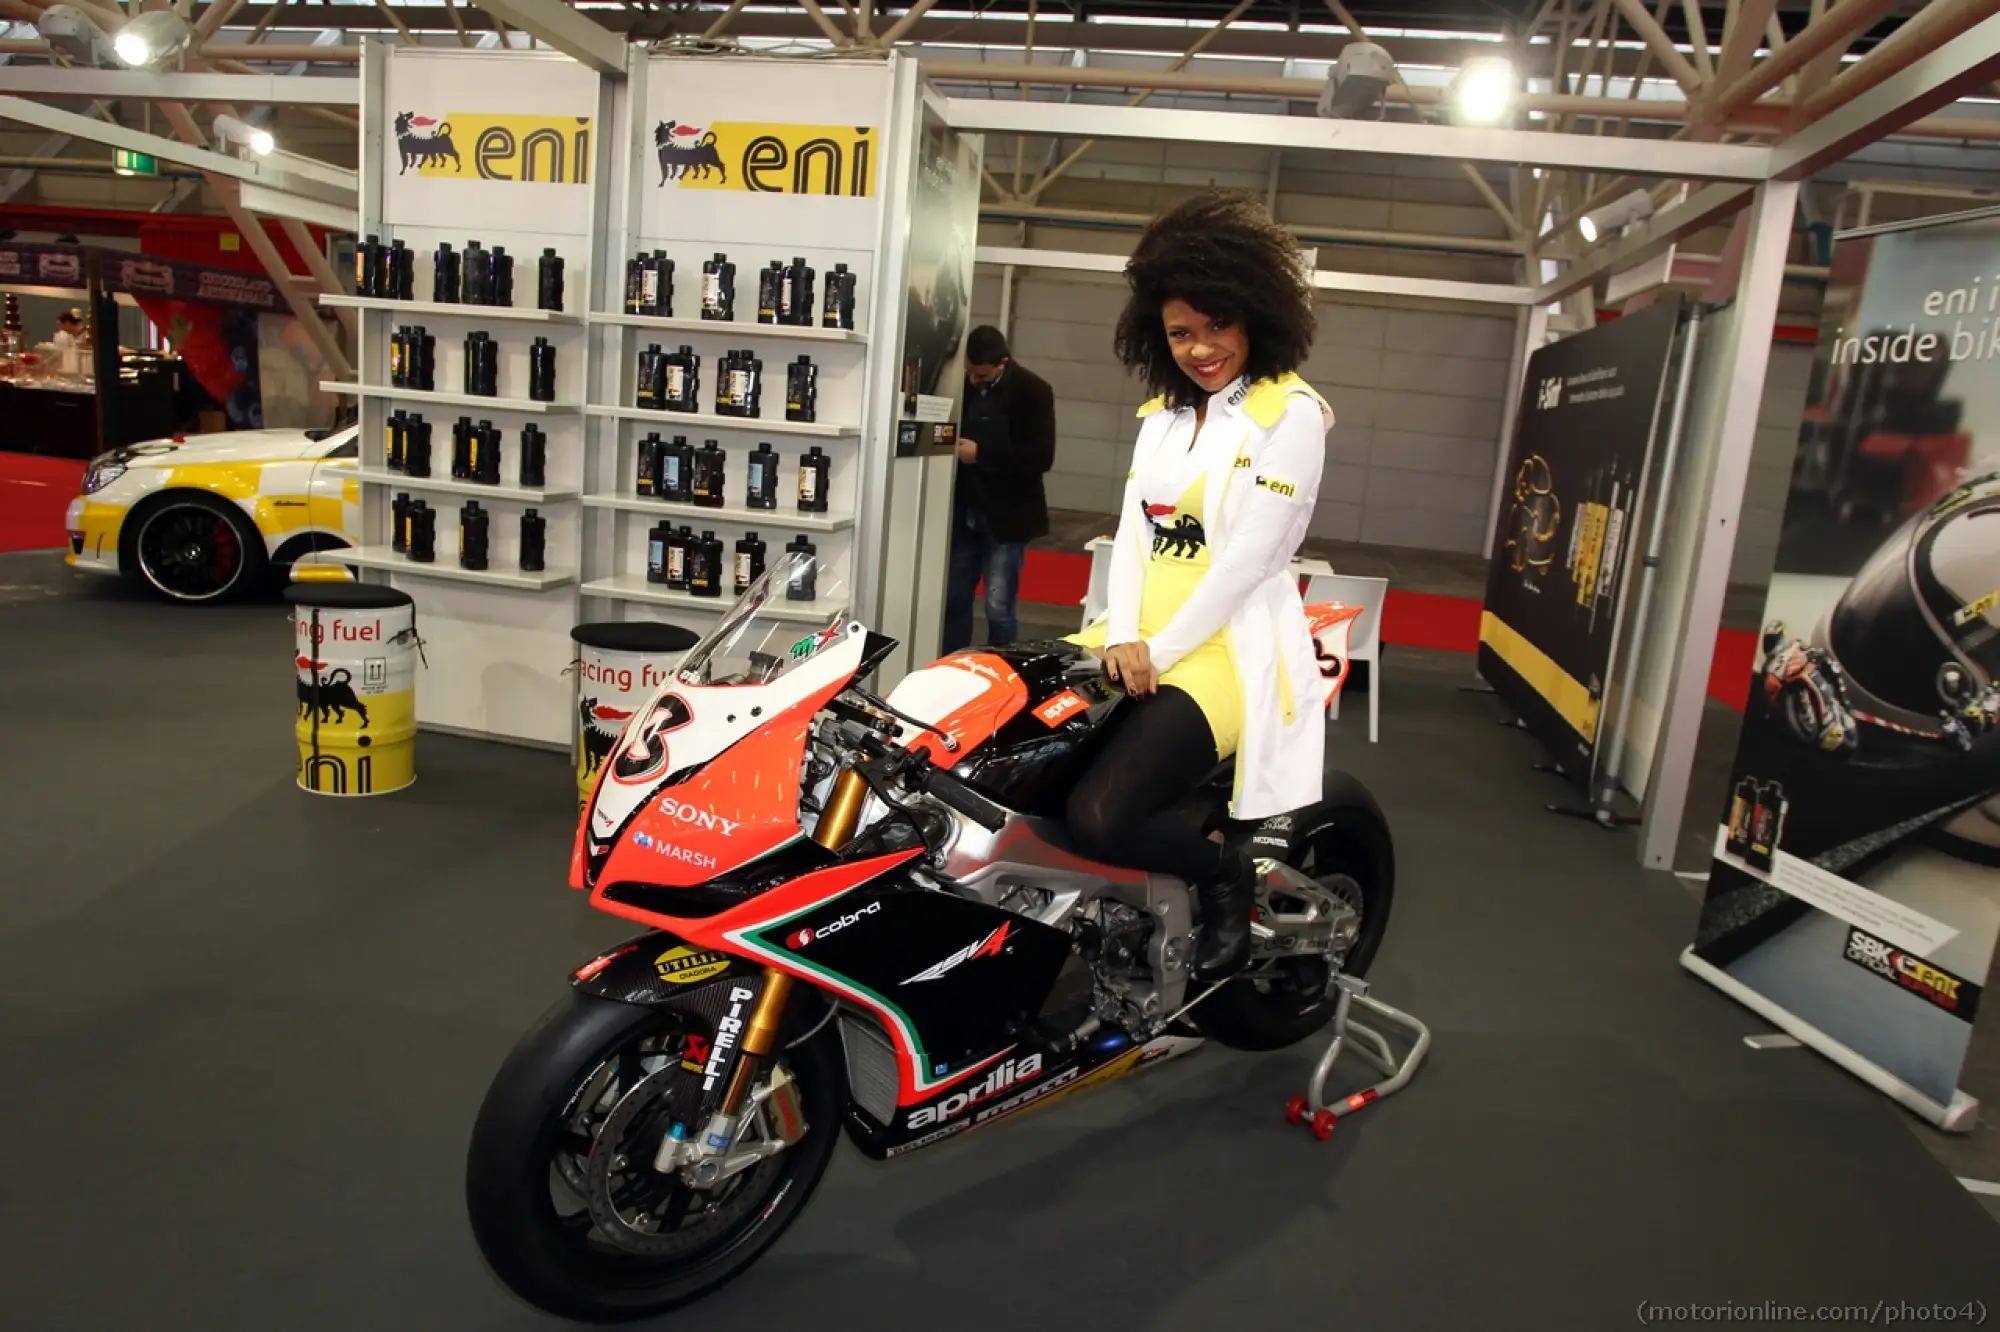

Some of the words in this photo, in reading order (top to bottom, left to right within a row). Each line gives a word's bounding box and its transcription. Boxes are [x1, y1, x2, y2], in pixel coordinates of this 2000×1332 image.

[474, 116, 590, 184] eni
[741, 126, 870, 198] eni
[1923, 276, 1982, 317] eni
[1830, 323, 1938, 365] inside
[1269, 480, 1295, 498] eni
[333, 619, 381, 642] fuel
[659, 797, 741, 837] SONY
[656, 839, 717, 870] MARSH
[815, 900, 882, 941] cobra
[1850, 930, 1893, 967] SBK
[702, 986, 754, 1091] PIRELLI
[907, 1053, 1043, 1130] aprilia
